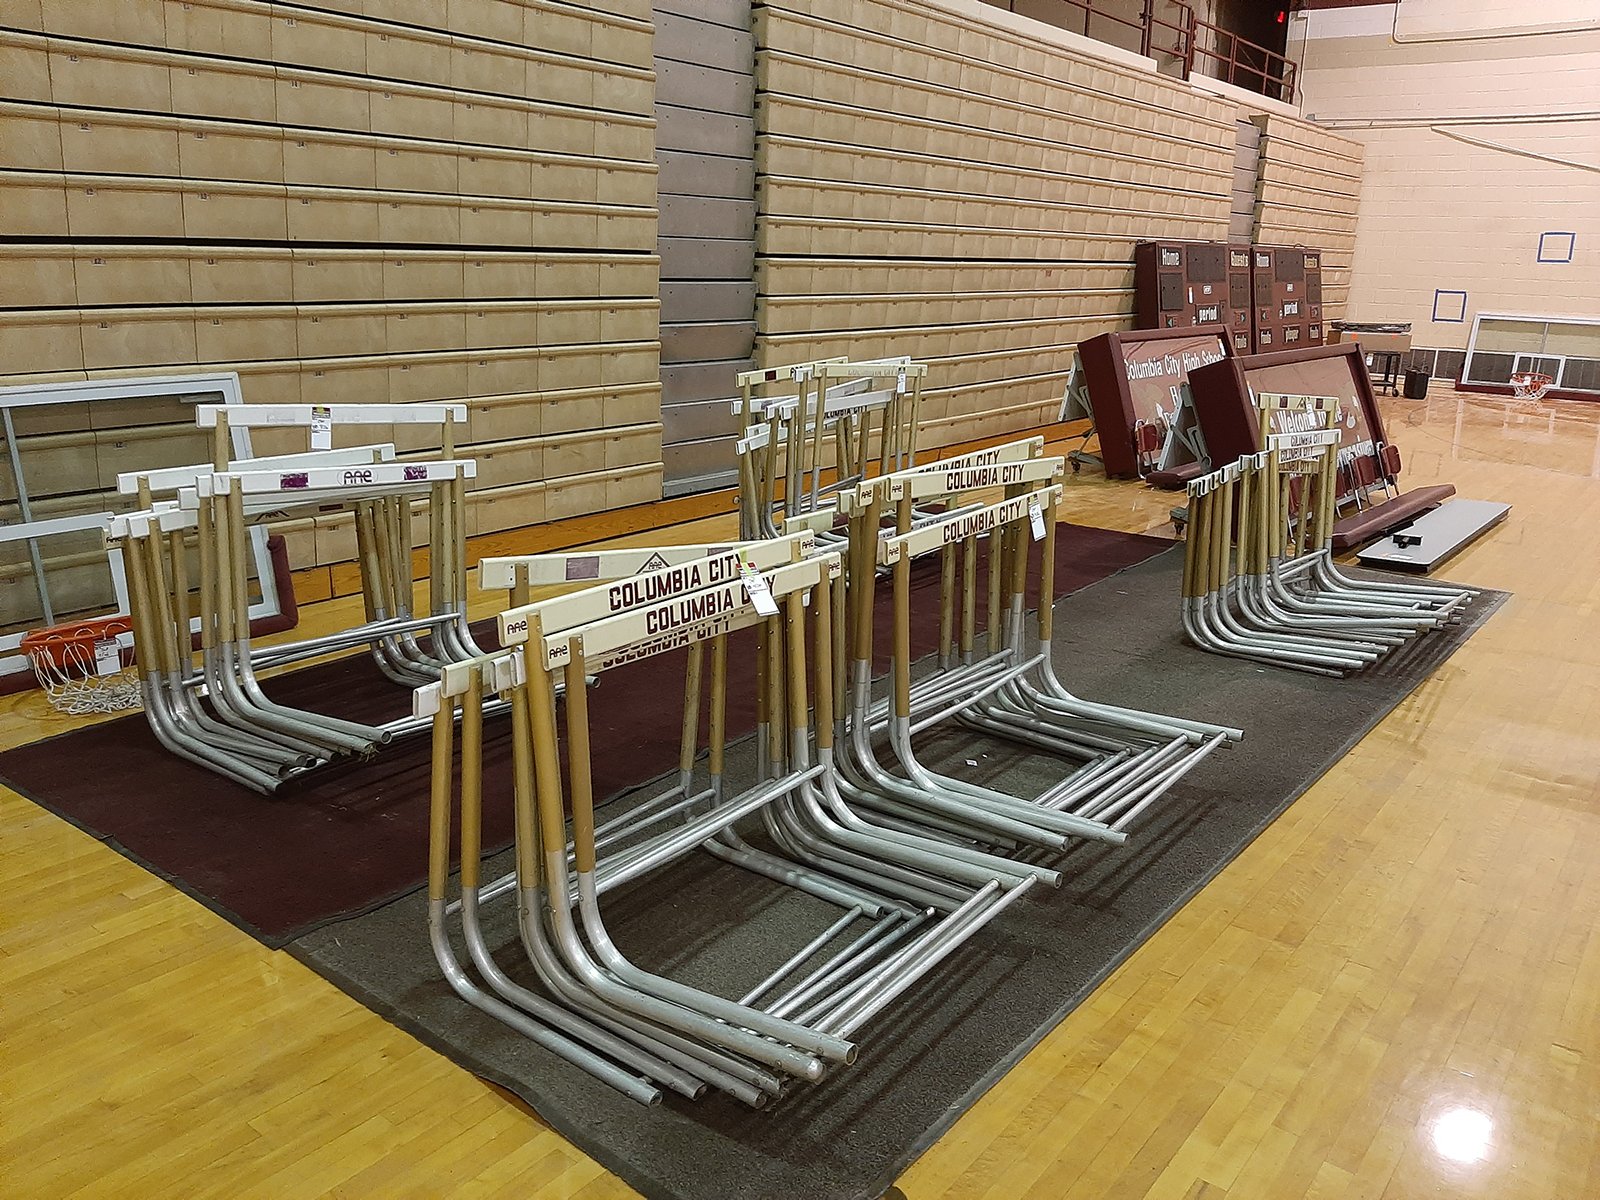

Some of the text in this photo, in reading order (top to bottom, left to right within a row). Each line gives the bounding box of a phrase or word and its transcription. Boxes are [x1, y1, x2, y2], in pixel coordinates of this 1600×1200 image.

[1161, 248, 1180, 266] Home
[1230, 250, 1249, 267] Guests
[1256, 252, 1270, 268] Home
[1199, 305, 1218, 323] period
[1283, 301, 1298, 317] period
[1124, 357, 1164, 380] Columbia
[1164, 355, 1181, 378] City
[1182, 352, 1201, 372] High
[1276, 410, 1316, 433] Welcom
[976, 450, 1000, 467] CITY
[946, 464, 1024, 490] COLUMBIA CITY
[943, 511, 995, 543] COLUMBIA
[999, 501, 1022, 523] CITY
[609, 565, 701, 611] COLUMBIA
[709, 553, 741, 582] CIT
[646, 588, 734, 635] COLUMBIA
[741, 574, 776, 605] CY
